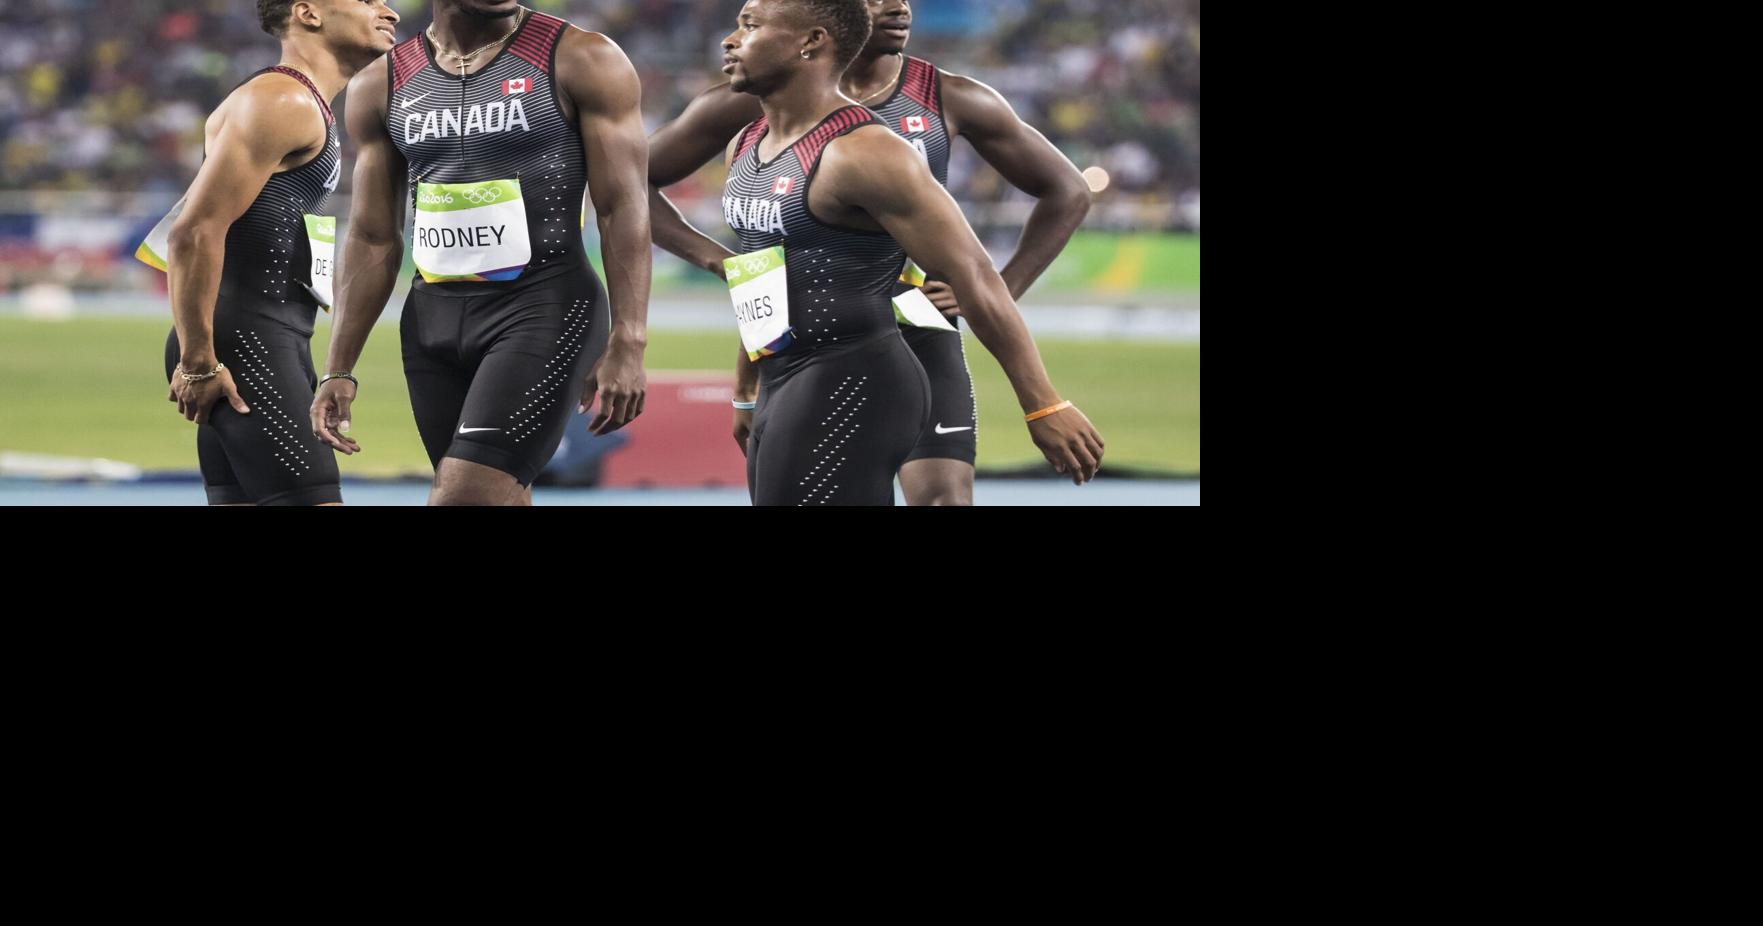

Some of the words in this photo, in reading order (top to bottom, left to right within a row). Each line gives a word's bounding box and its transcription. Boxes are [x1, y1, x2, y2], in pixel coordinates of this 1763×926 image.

[404, 98, 530, 144] CANADA
[722, 196, 790, 236] ANADA
[419, 225, 506, 248] RODNEY
[315, 258, 327, 276] DE
[736, 295, 773, 324] AYNES
